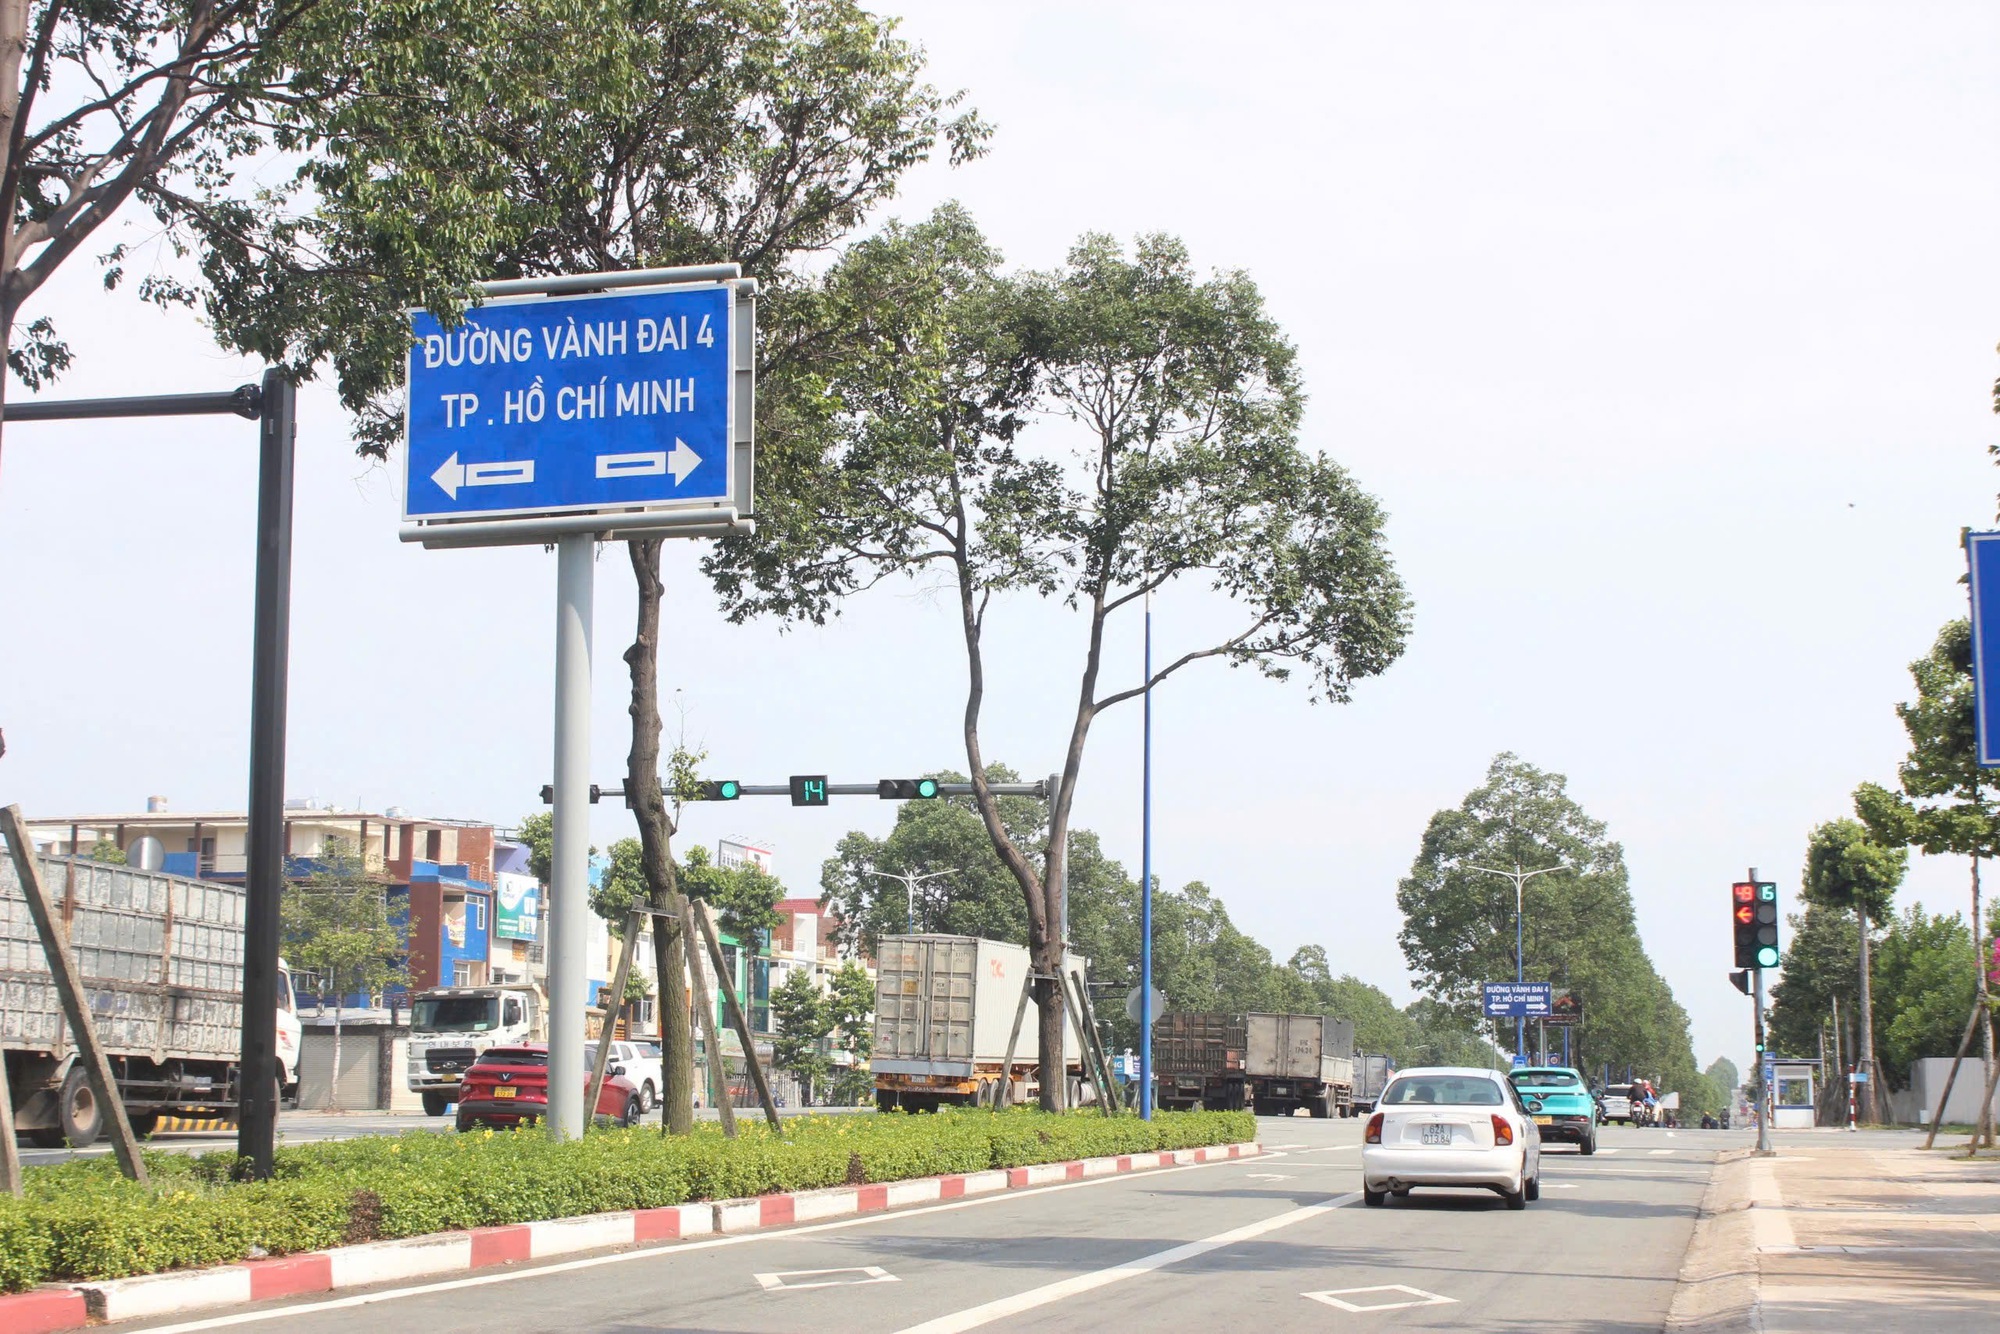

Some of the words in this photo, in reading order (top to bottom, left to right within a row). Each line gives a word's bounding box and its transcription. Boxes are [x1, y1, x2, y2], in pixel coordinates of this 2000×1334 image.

[424, 322, 533, 368] ĐƯỜNG
[542, 316, 627, 360] VÀNH
[636, 315, 687, 353] ĐAI
[696, 313, 715, 348] 4
[504, 375, 546, 424] HỒ
[557, 375, 608, 421] CHÍ
[616, 377, 695, 417] MINH
[805, 780, 824, 801] 14
[1511, 985, 1530, 993] VÀNH
[1514, 994, 1526, 1002] CHÍ
[1429, 1125, 1445, 1134] 62A
